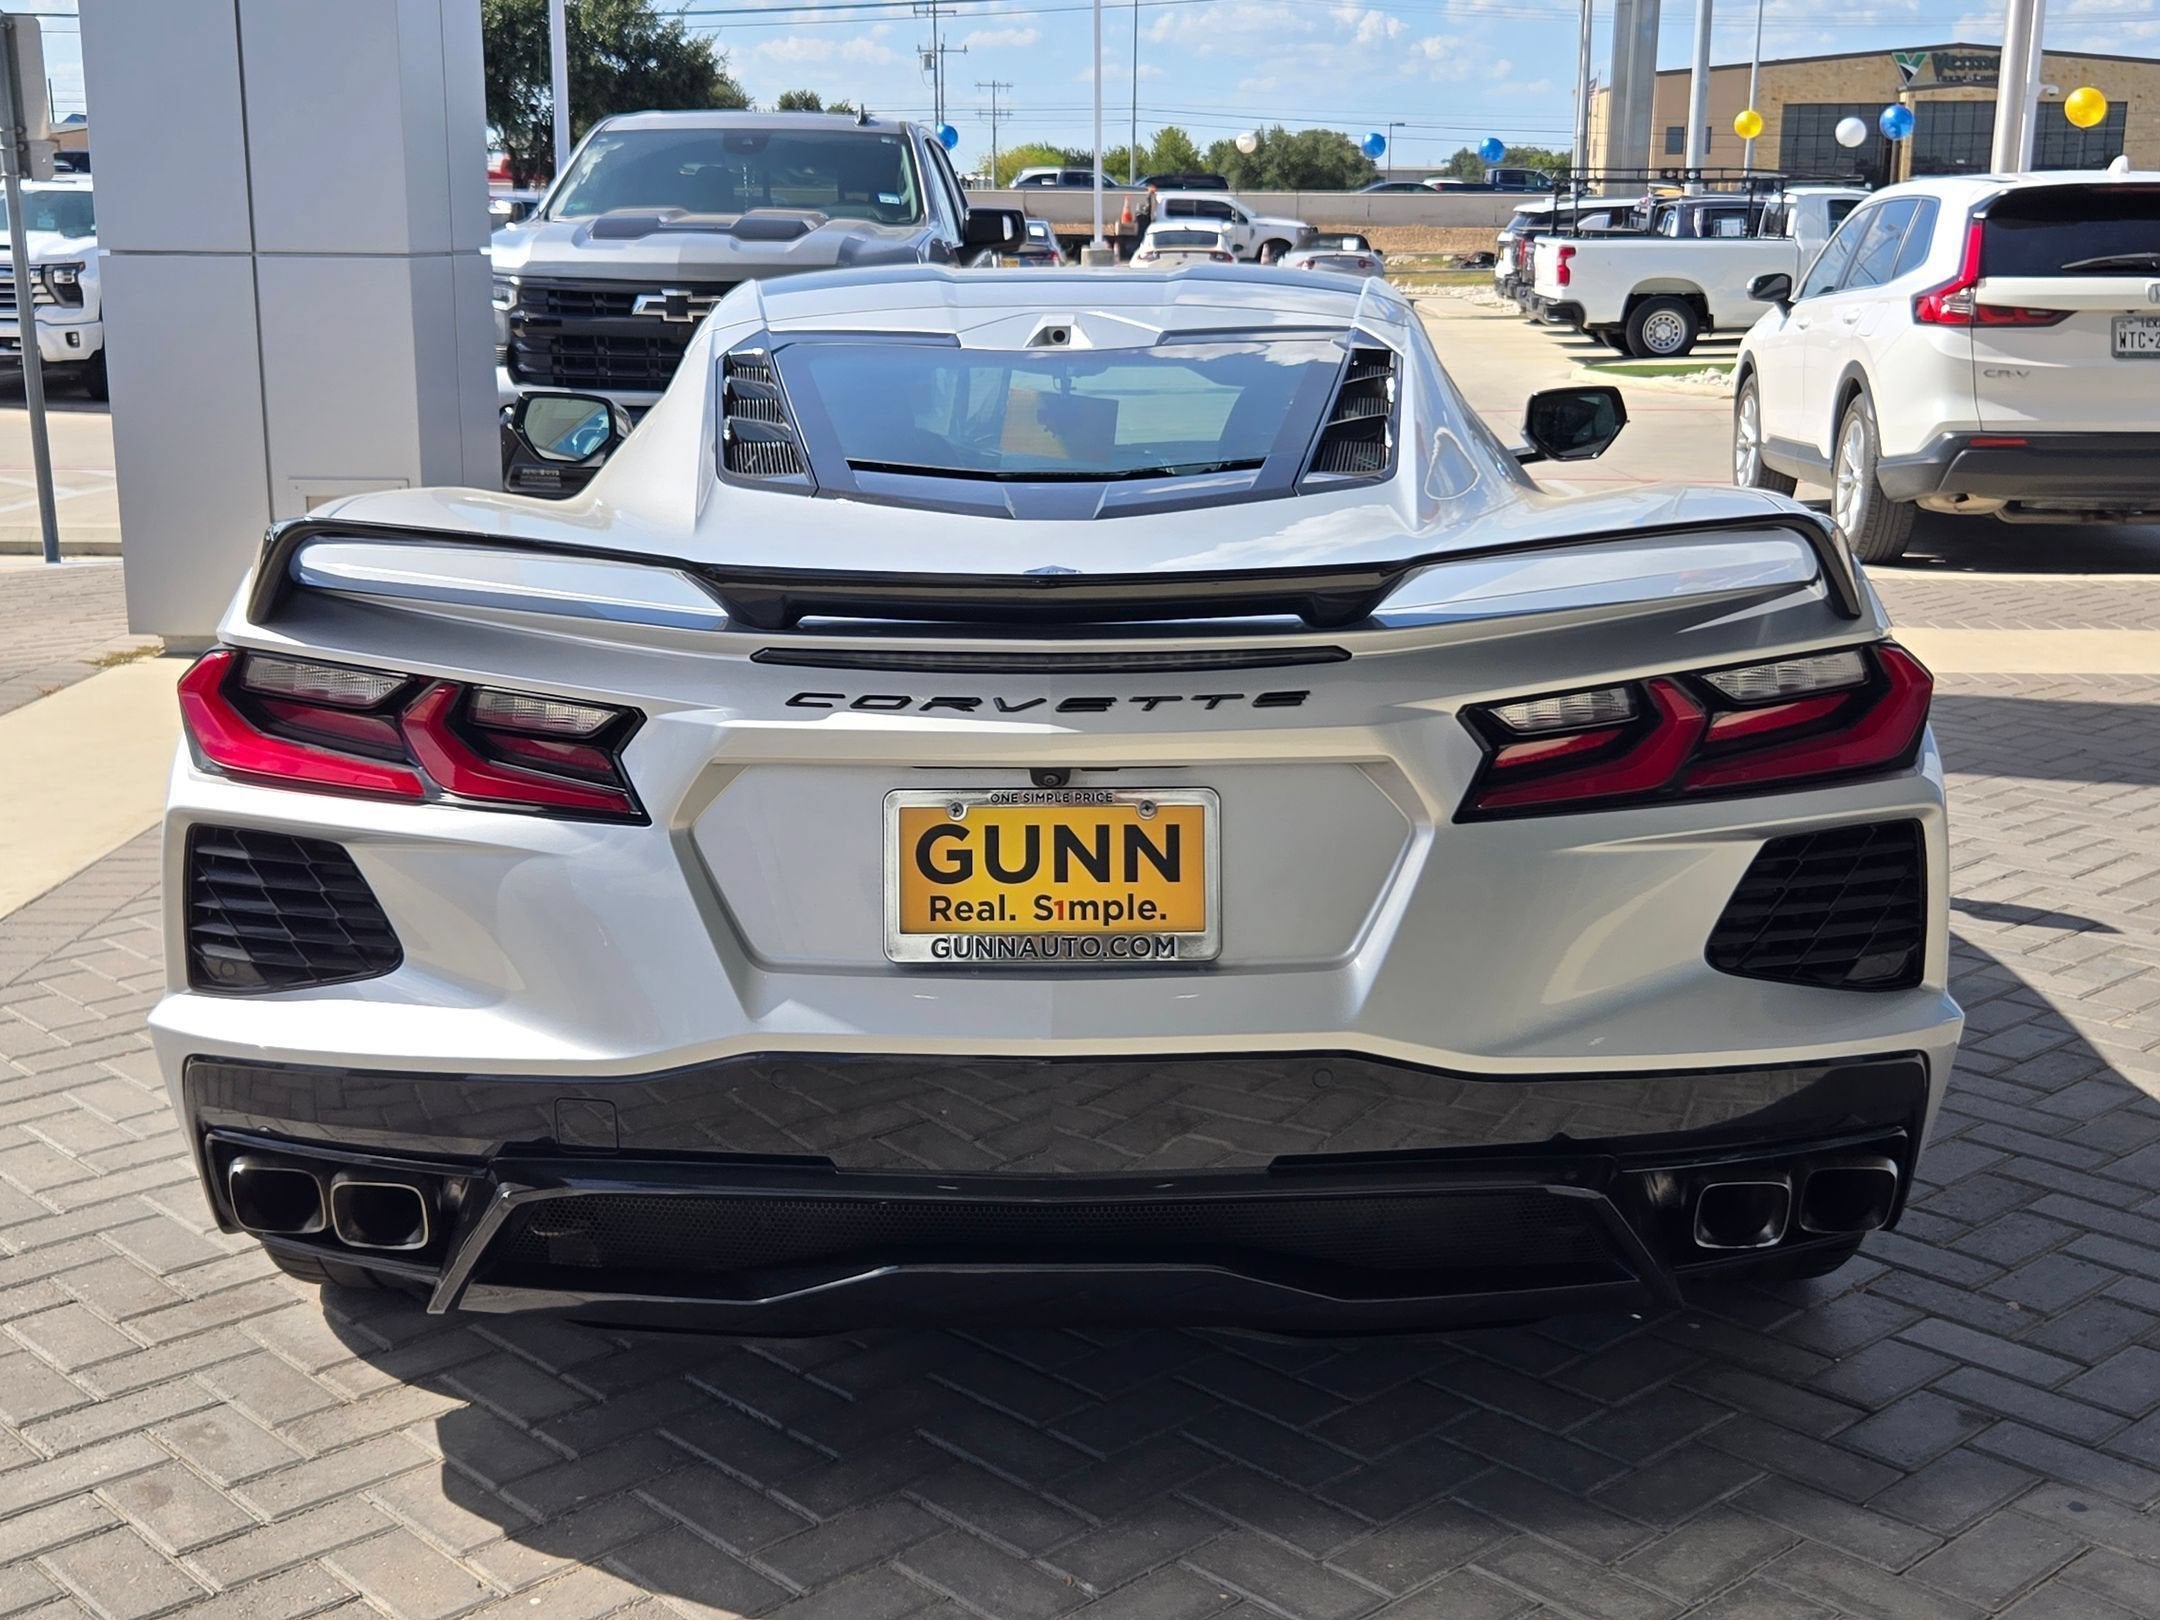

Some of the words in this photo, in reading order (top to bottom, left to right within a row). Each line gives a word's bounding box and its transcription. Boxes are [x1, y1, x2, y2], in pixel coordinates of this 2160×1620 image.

[785, 690, 1311, 713] CORVETTE
[990, 793, 1018, 803] ONE
[1023, 792, 1069, 803] SIMPLE
[1075, 792, 1113, 803] PRICE
[915, 823, 1181, 884] GUNN
[929, 894, 1016, 922] Real.
[931, 936, 1176, 959] GUNNAUTO.COM
